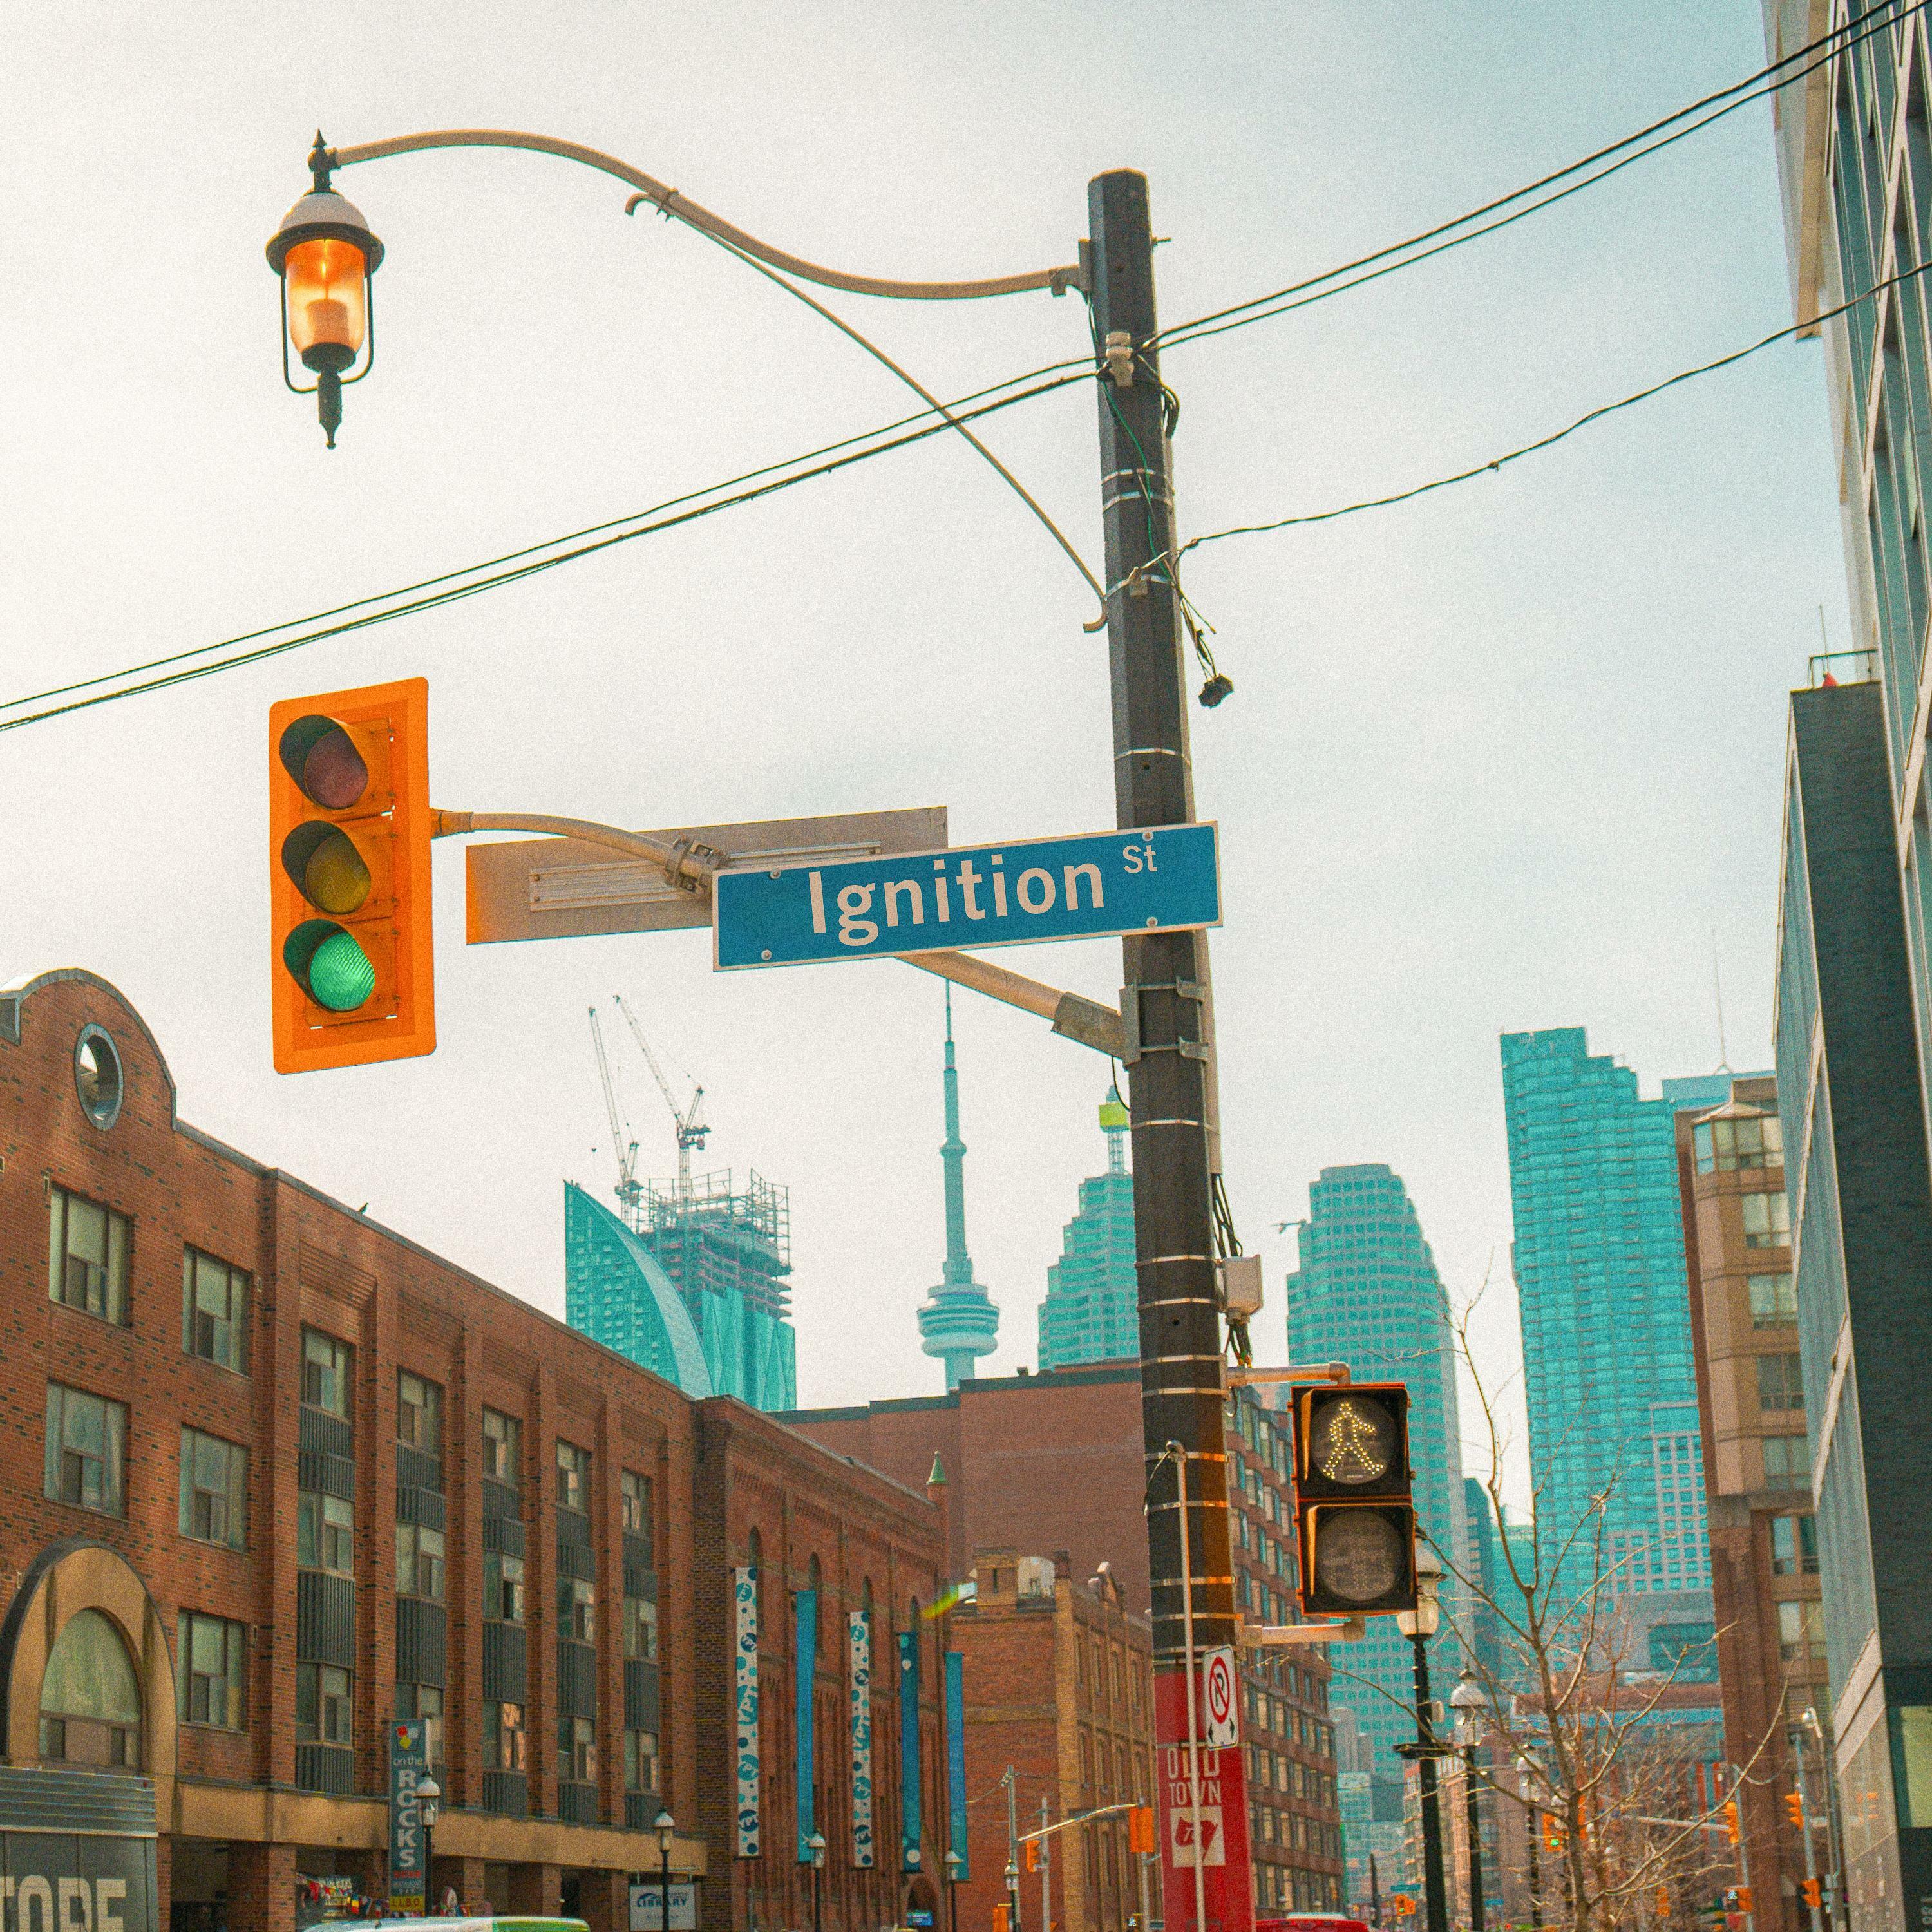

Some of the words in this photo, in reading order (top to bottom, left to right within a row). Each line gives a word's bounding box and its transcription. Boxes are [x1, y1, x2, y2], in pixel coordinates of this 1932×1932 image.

[809, 854, 1104, 946] Ignition
[1123, 845, 1157, 873] St
[737, 1685, 758, 1723] YPT
[1168, 1748, 1220, 1779] OLD
[1169, 1779, 1222, 1806] TOWN
[397, 1770, 419, 1867] ROCKS
[637, 1897, 687, 1907] LIBRRY
